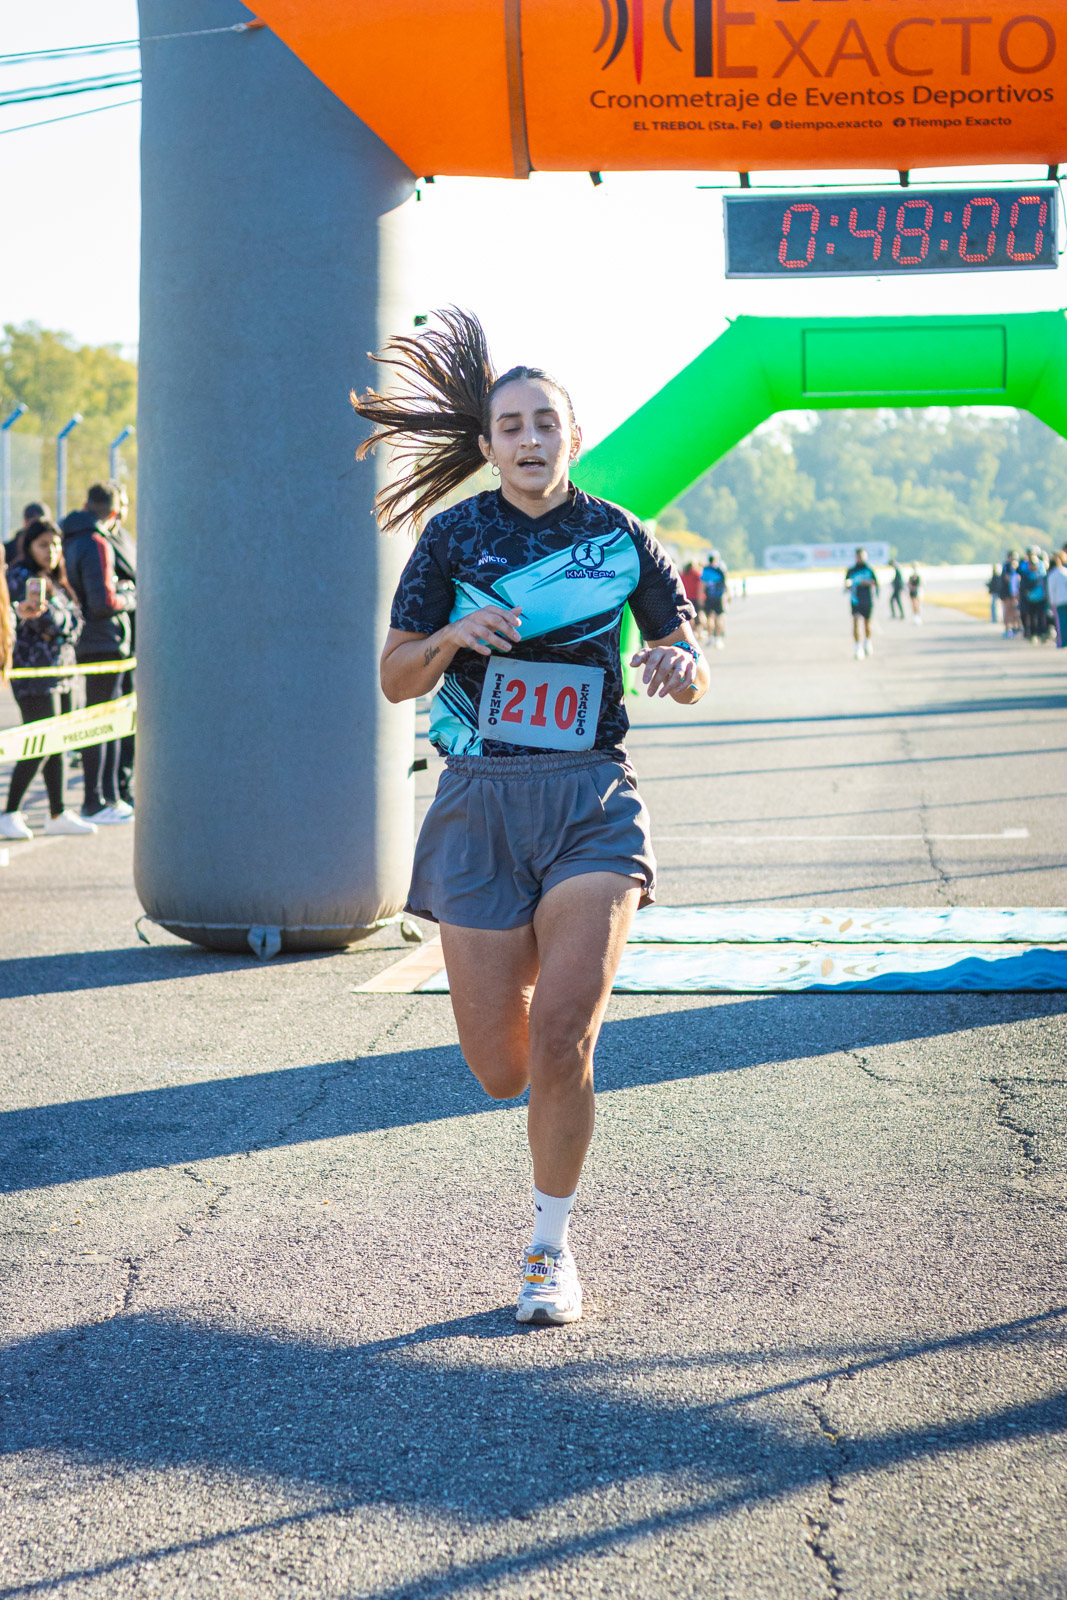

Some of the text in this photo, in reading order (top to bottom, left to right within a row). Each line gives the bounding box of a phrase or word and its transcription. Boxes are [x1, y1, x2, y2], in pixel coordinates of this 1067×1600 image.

[590, 84, 1054, 112] Cronometraje de Eventos Deportivos
[633, 116, 1012, 132] EL TREBOL (Sta. Fe) tiempo.exacto Tiempo Exacto
[778, 195, 1048, 269] 0:48:00
[586, 570, 615, 579] TEAM
[488, 673, 504, 726] TIEMPO
[500, 679, 578, 730] 210
[575, 683, 590, 736] EXACTO
[63, 723, 113, 744] PRECAUCION
[531, 1264, 548, 1275] 210
